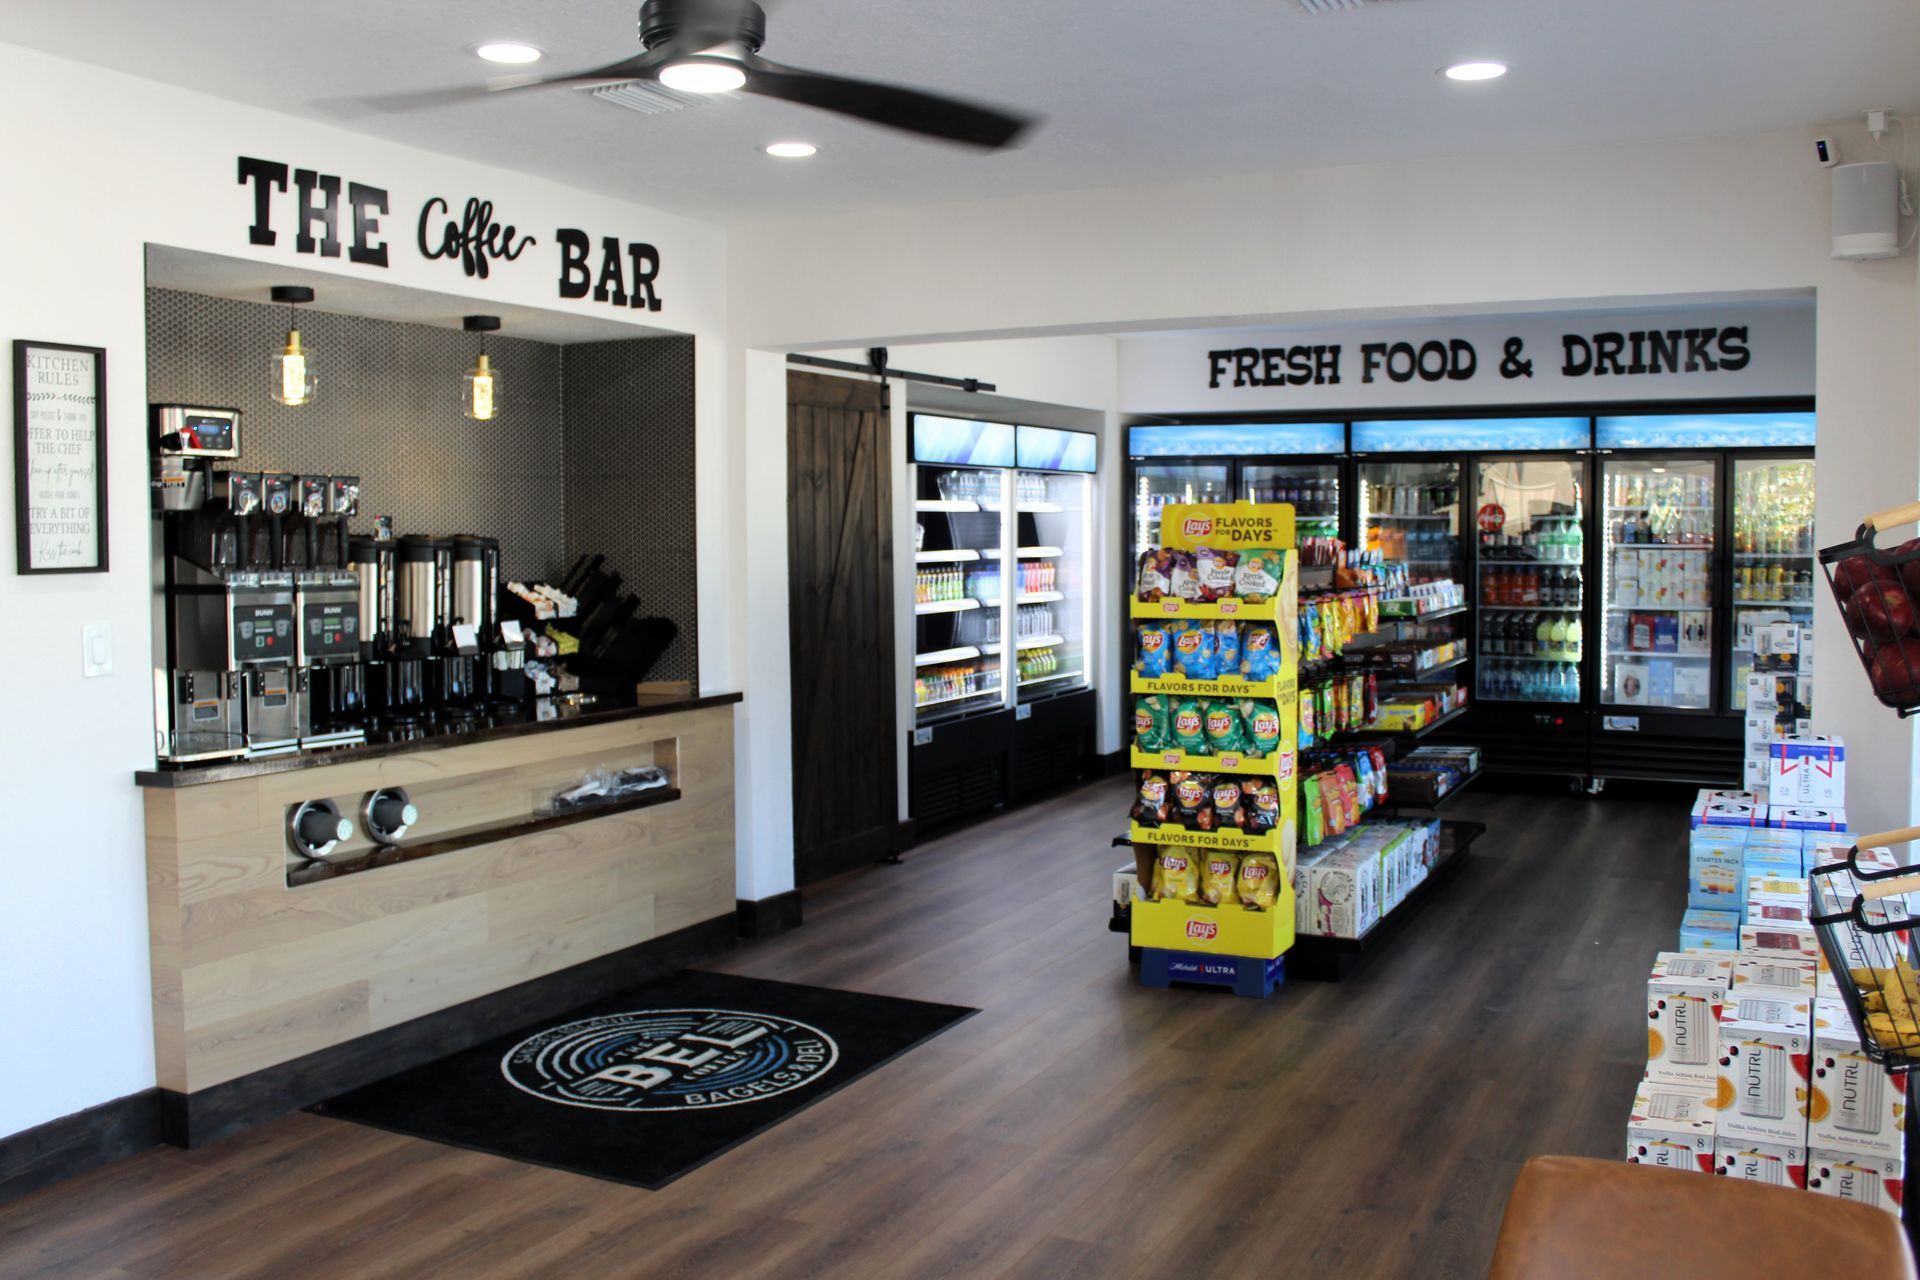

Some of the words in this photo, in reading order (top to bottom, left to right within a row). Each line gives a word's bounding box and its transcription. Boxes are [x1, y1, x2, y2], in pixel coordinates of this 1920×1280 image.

[238, 156, 389, 268] THE
[418, 197, 536, 279] Coffee
[556, 228, 662, 312] BAR
[27, 355, 88, 372] KITCHEN
[1208, 344, 1341, 388] FRESH
[1360, 339, 1477, 384] FOOD
[1499, 337, 1533, 379] &
[1562, 326, 1751, 377] DRINKS
[38, 371, 79, 386] RULES
[28, 427, 52, 440] FFER
[55, 428, 69, 440] TO
[71, 428, 95, 442] HELP
[35, 442, 55, 454] THE
[58, 443, 81, 455] CHEF
[30, 507, 47, 519] TRY
[50, 507, 58, 519] A
[60, 507, 76, 519] BIT
[78, 507, 90, 519] OF
[30, 522, 90, 535] EVERYTHING
[1184, 520, 1211, 536] Lay's
[1216, 518, 1272, 527] FLAVORS
[1232, 530, 1272, 541] DAYS
[1143, 633, 1162, 648] ay's
[1148, 682, 1194, 691] FLAVORS
[1198, 684, 1218, 692] FOR
[1222, 685, 1249, 693] DAYS
[1177, 717, 1199, 730] Lay's
[1208, 717, 1230, 730] Lay's
[1254, 720, 1279, 733] Lay's
[1213, 786, 1237, 800] Lay's
[1148, 832, 1195, 843] FLAVORS
[1198, 836, 1218, 845] FOR
[1222, 838, 1249, 847] DAYS
[1164, 857, 1186, 871] Lay's
[1188, 921, 1216, 939] Lay's
[1205, 965, 1235, 974] ULTRA
[597, 1026, 768, 1089] BEL
[684, 1071, 802, 1105] BAGELS
[793, 1040, 825, 1062] DELI
